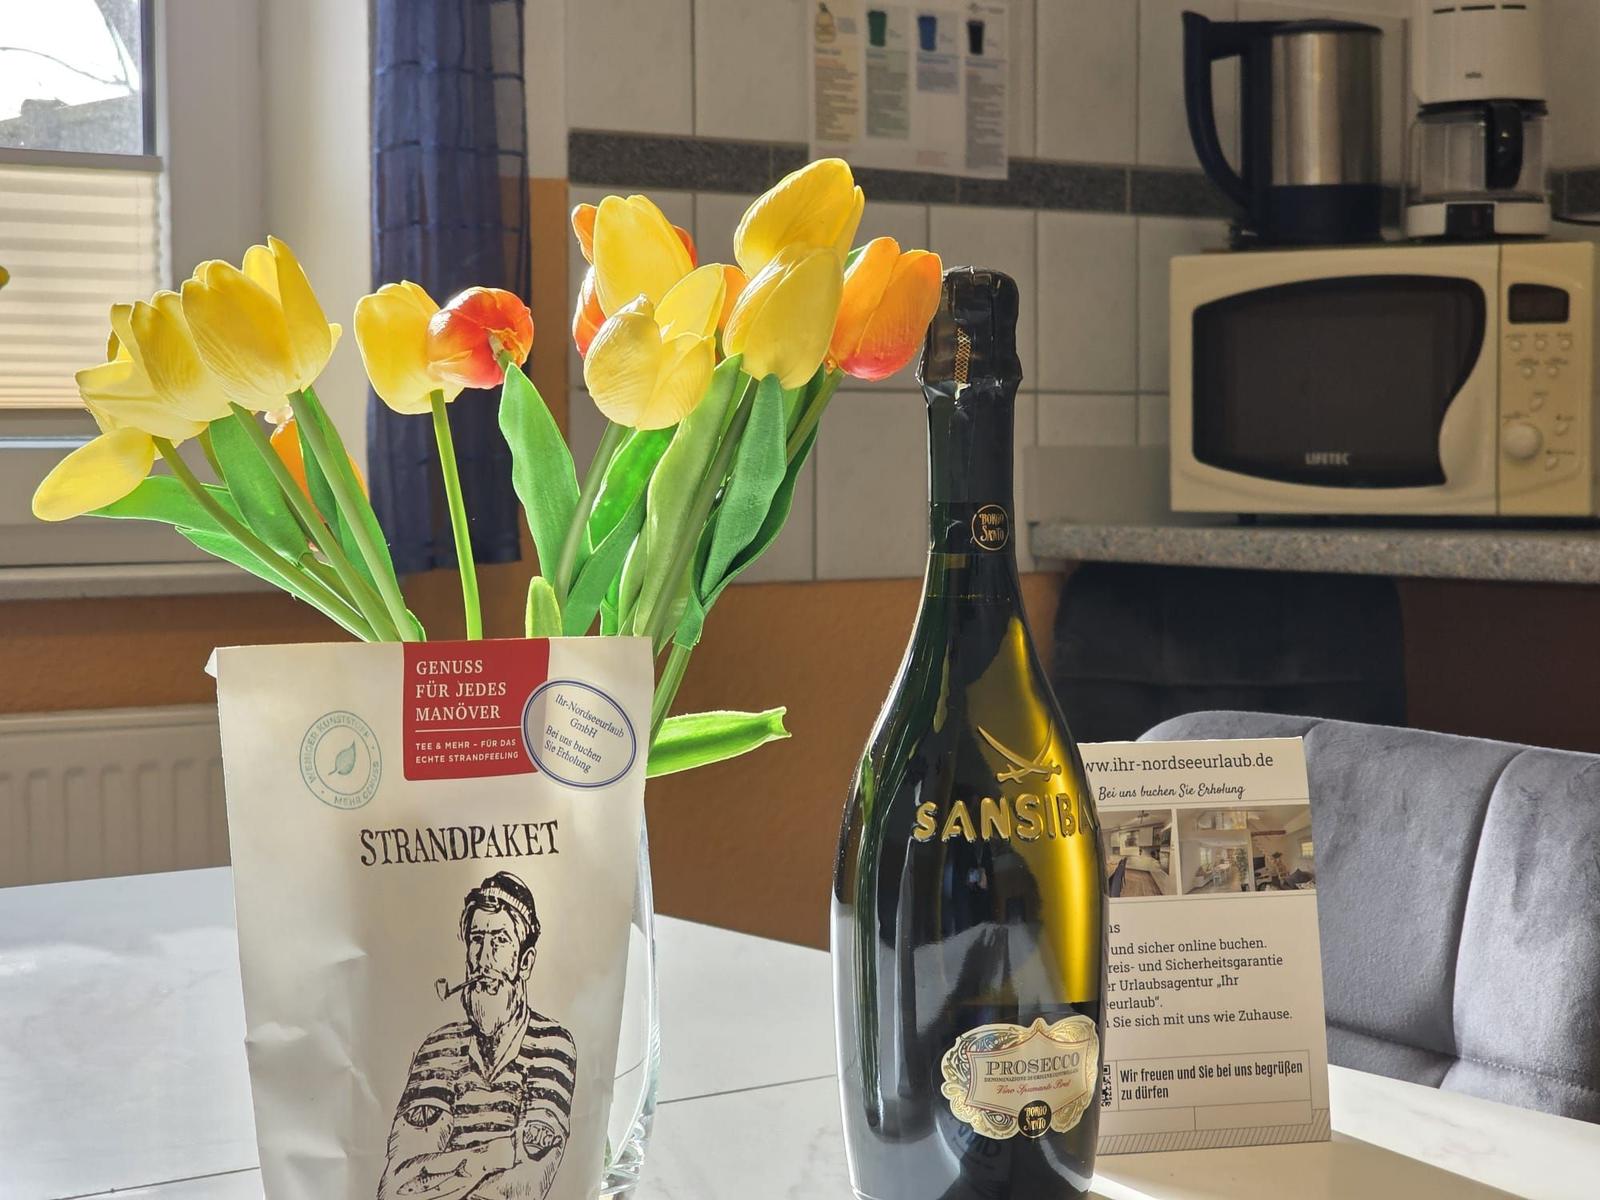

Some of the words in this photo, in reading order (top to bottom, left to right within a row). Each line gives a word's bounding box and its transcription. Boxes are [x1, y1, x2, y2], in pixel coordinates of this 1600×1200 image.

[416, 659, 483, 675] GENUSS
[416, 680, 450, 698] FÜR
[456, 681, 507, 698] JEDES
[416, 702, 501, 721] MANÖVER
[555, 694, 625, 738] Ihr-Nordseeurlaub
[570, 717, 598, 739] GmbH
[416, 743, 433, 751] TEE
[436, 742, 442, 750] &
[445, 741, 470, 750] MEHR
[481, 739, 498, 748] FÜR
[500, 739, 516, 747] DAS
[545, 725, 560, 738] Bei
[559, 734, 573, 746] uns
[573, 740, 602, 763] buchen
[416, 755, 446, 764] ECHTE
[449, 751, 519, 762] STRANDFEELING
[544, 739, 556, 753] Sie
[556, 747, 592, 774] Erholung
[1086, 752, 1274, 773] ww.ihr-nordseeurlaub.de
[1098, 786, 1117, 801] Bei
[1119, 789, 1137, 798] uns
[1140, 785, 1176, 797] buchen
[1178, 783, 1196, 798] Sie
[1197, 782, 1246, 800] Erholung
[360, 819, 561, 867] STRANDPAKET
[1110, 942, 1135, 956] und
[1137, 941, 1175, 954] sicher
[1178, 939, 1217, 953] online
[1219, 937, 1267, 951] buchen.
[1108, 961, 1135, 974] reis-
[1138, 960, 1163, 972] und
[1165, 954, 1283, 971] Sicherheitsgarantie
[1119, 976, 1213, 992] Urlaubsagentur
[1113, 1015, 1132, 1028] Sie
[1135, 1014, 1160, 1027] sich
[1163, 1012, 1185, 1025] mit
[1187, 1014, 1211, 1024] uns
[1213, 1010, 1236, 1023] wie
[1238, 1008, 1293, 1022] Zuhause.
[985, 1052, 1080, 1076] PROSECCO
[1120, 1068, 1138, 1083] Wir
[1141, 1067, 1174, 1082] freuen
[1177, 1065, 1196, 1080] und
[1198, 1065, 1214, 1079] Sie
[1216, 1063, 1232, 1078] bei
[1234, 1063, 1253, 1077] uns
[1255, 1060, 1303, 1078] begrüßen
[1120, 1089, 1132, 1101] zu
[1135, 1085, 1169, 1100] dürfen
